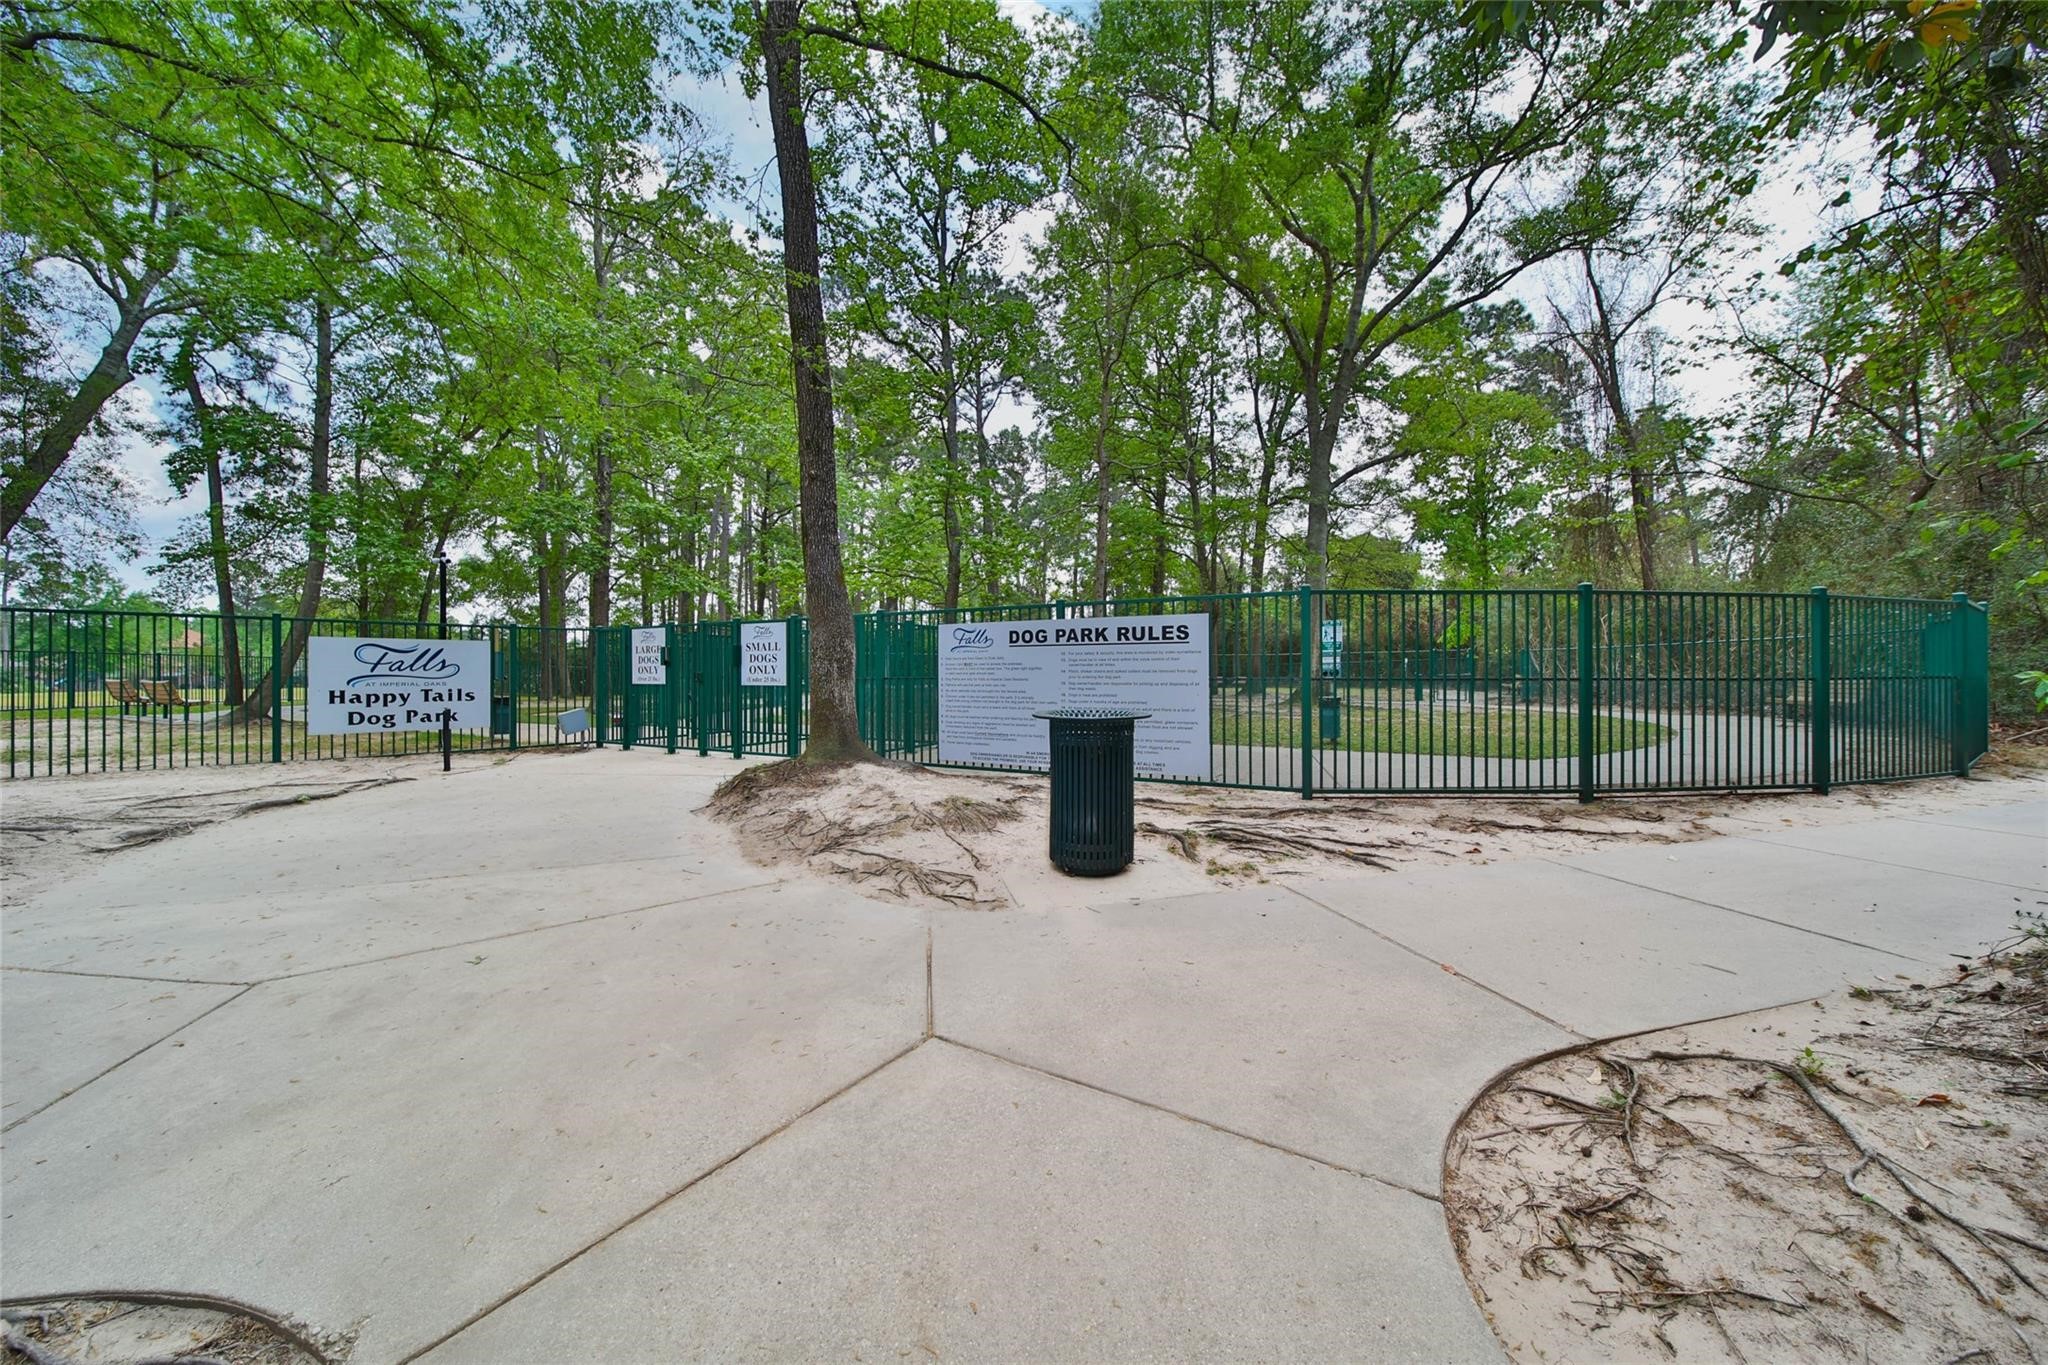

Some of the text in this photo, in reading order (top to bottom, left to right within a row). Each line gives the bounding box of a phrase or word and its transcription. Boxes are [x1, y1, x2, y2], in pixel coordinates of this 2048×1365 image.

[953, 627, 994, 649] Falls
[1009, 625, 1190, 645] DOG PARK RULES
[745, 642, 781, 652] SMALL
[354, 643, 460, 680] Falls
[638, 655, 659, 664] DOGS
[749, 653, 778, 663] DOGS
[638, 666, 659, 675] ONLY
[749, 664, 778, 675] ONLY
[328, 688, 476, 708] Happy Tails
[348, 711, 396, 729] Dog
